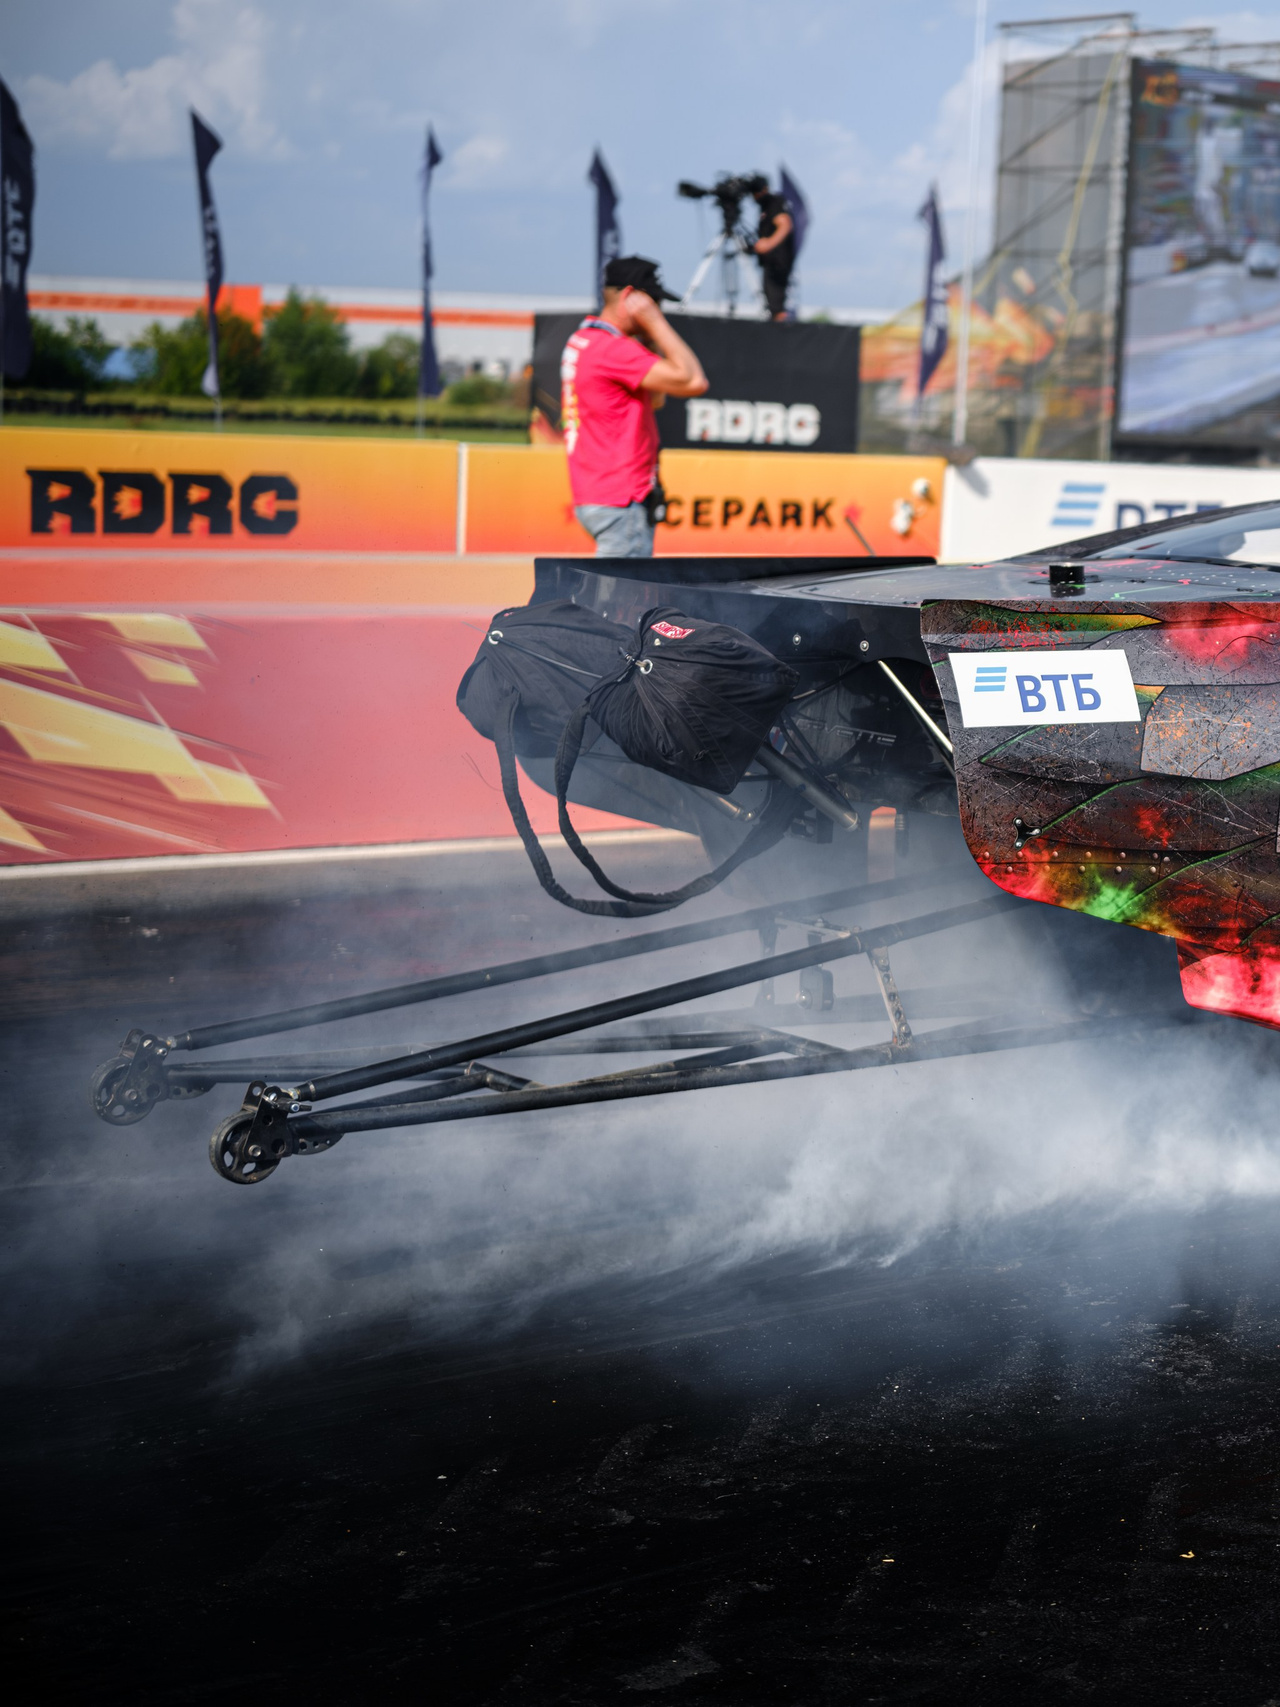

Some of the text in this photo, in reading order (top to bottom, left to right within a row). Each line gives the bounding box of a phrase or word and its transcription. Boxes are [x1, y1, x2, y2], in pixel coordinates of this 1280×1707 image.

[686, 398, 821, 446] RDRC
[26, 468, 298, 535] RDRC
[1016, 673, 1102, 713] ВТБ
